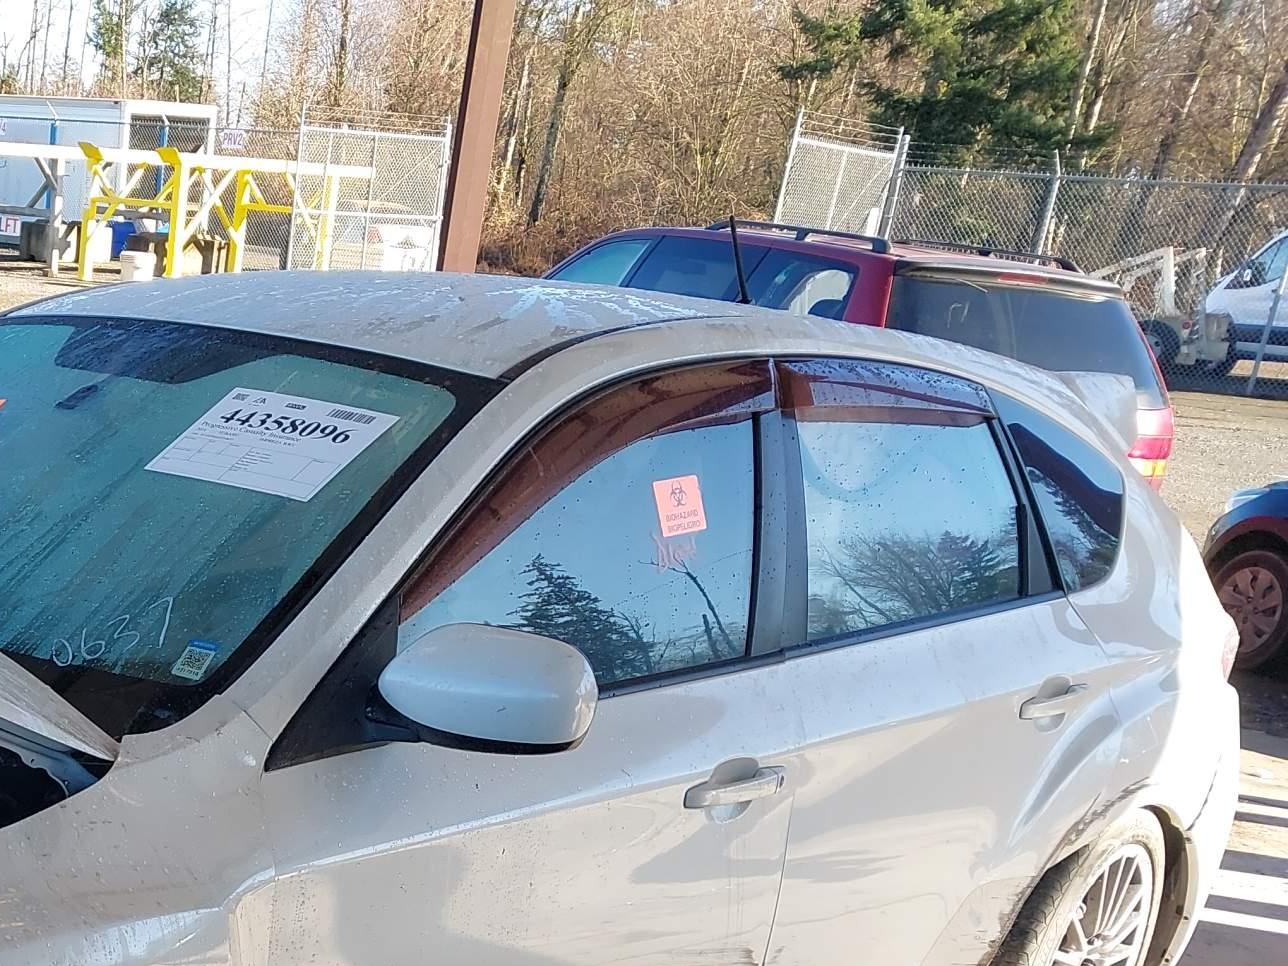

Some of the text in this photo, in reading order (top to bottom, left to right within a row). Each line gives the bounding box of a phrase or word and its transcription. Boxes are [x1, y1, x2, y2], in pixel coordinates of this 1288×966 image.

[223, 132, 244, 146] PRV2
[219, 408, 359, 443] 44358096
[665, 509, 699, 523] BIOHAZARD
